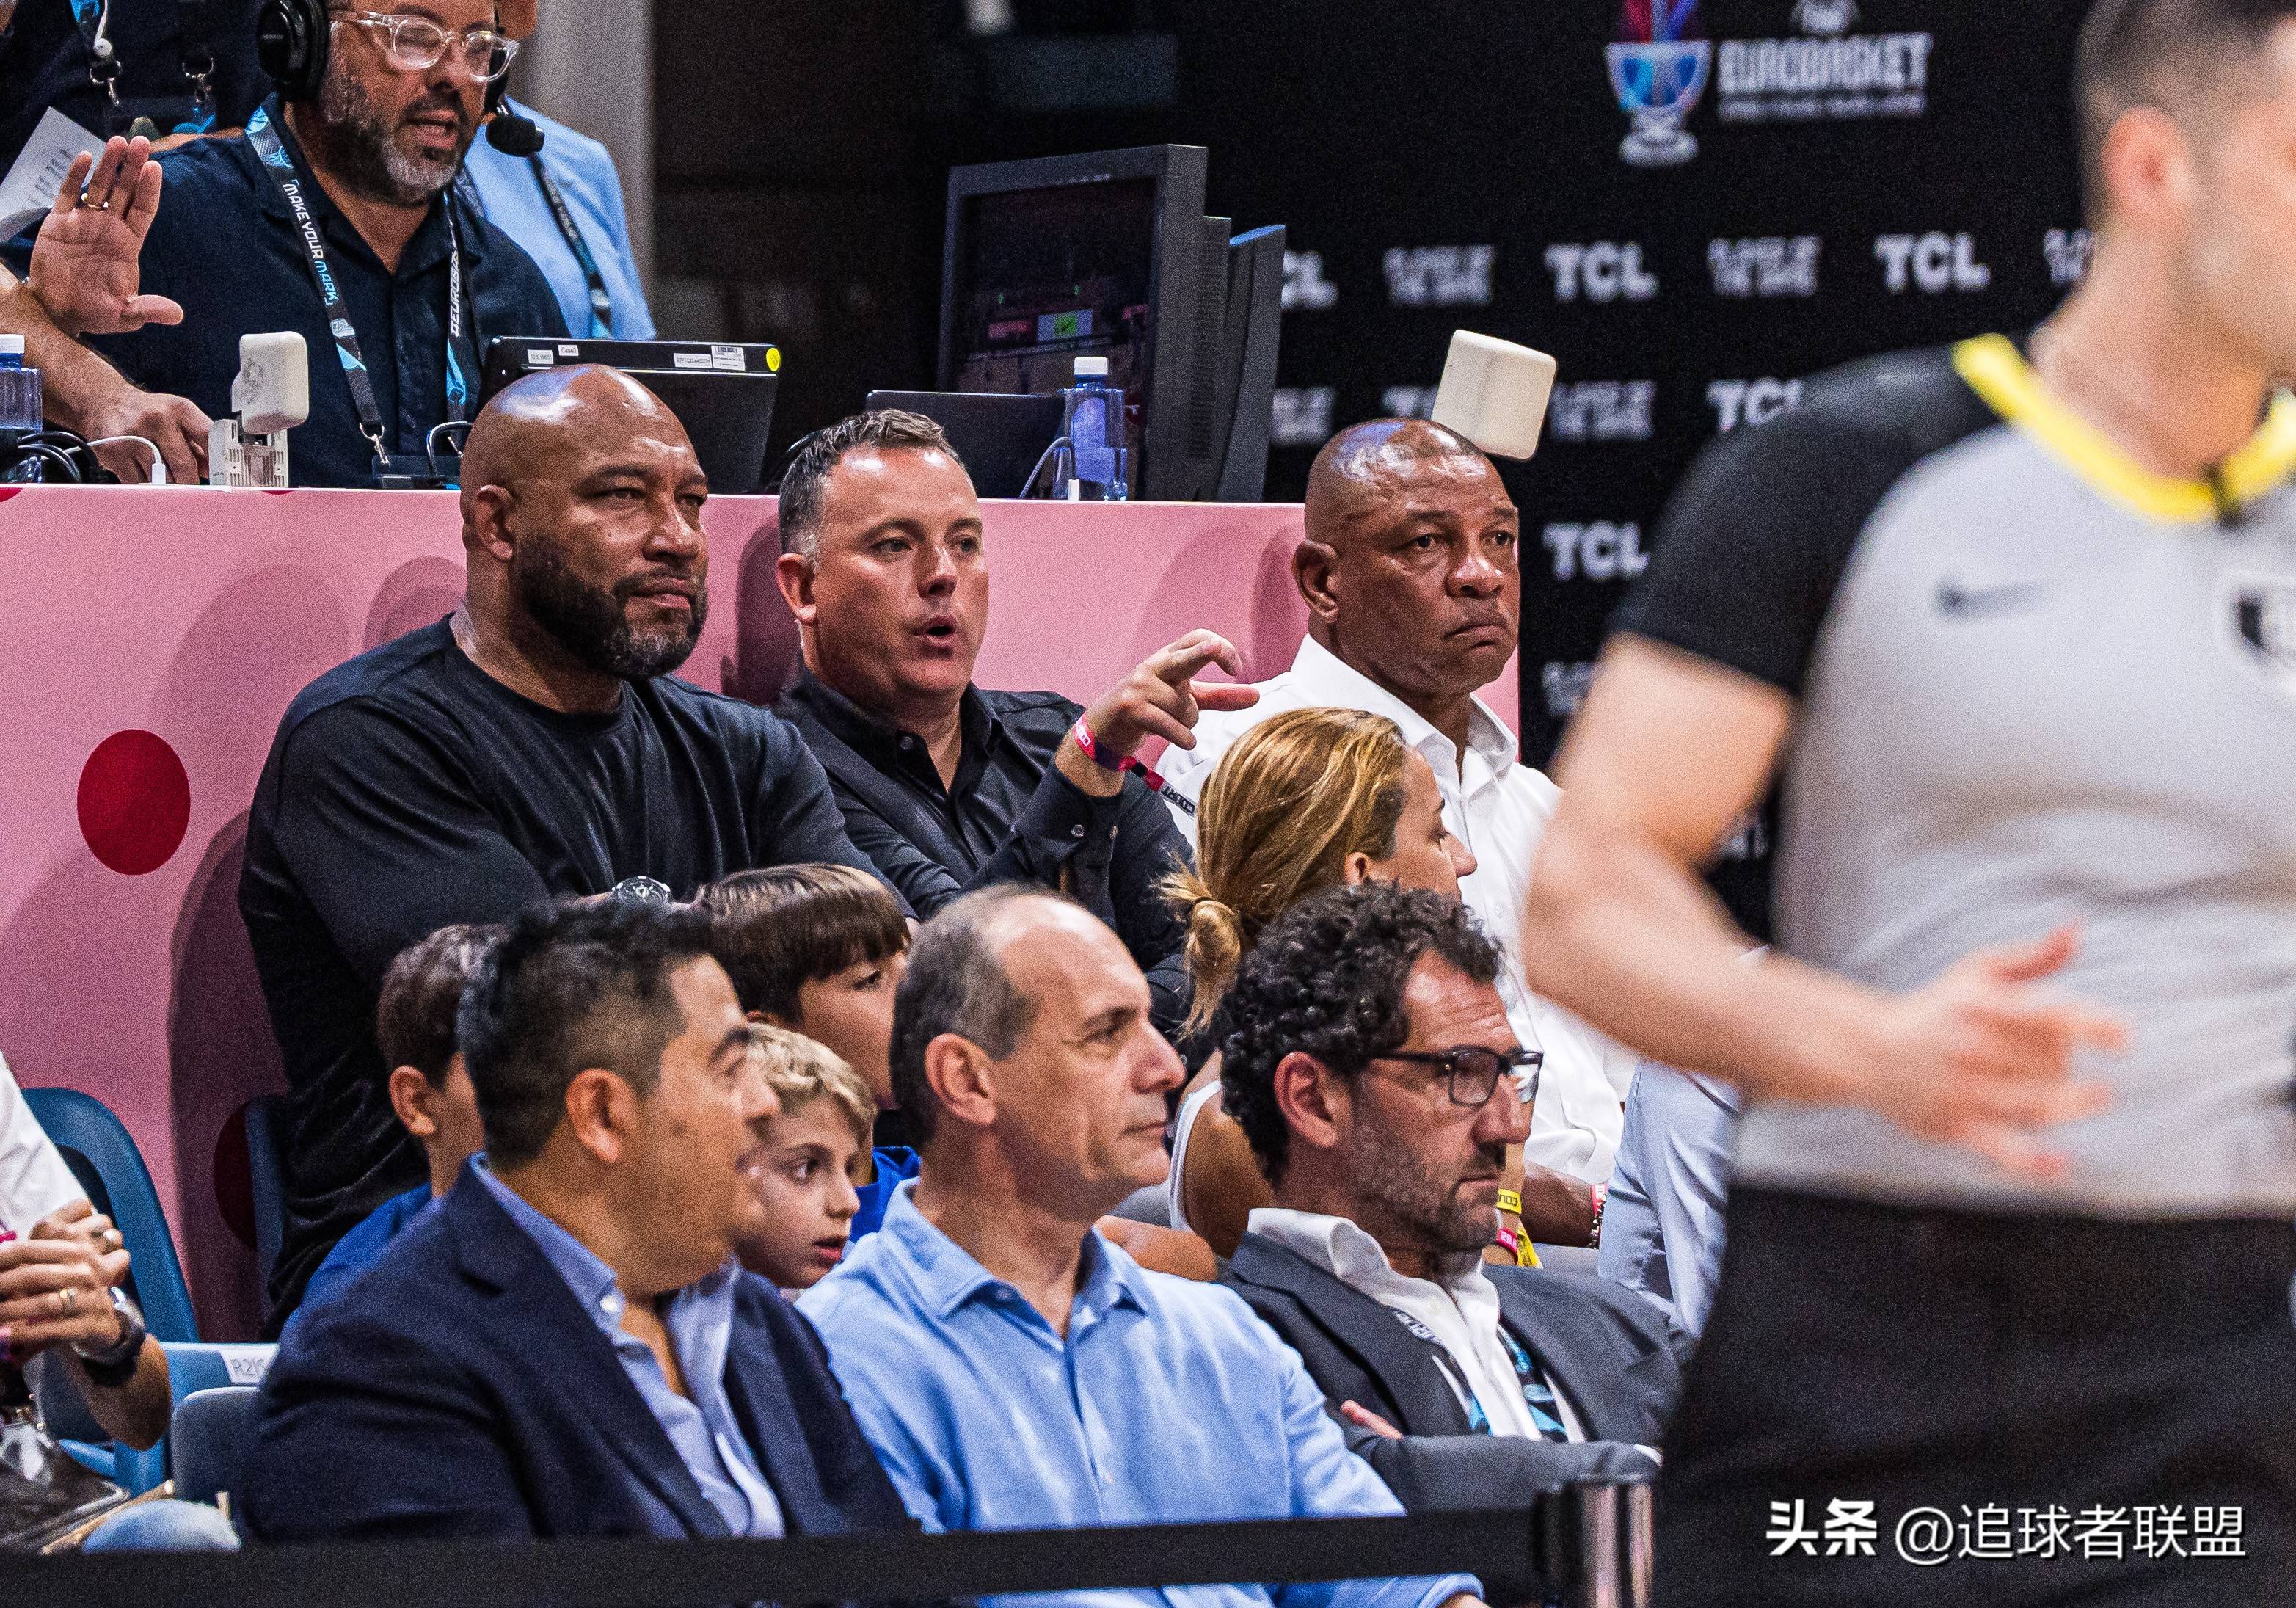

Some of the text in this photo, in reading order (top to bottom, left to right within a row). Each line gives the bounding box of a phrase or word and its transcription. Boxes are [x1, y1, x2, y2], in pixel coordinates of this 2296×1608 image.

[283, 183, 339, 301] MAKE YOUR MARK
[1545, 241, 1657, 299] TCL
[1873, 231, 1990, 292] TCL
[1281, 250, 1338, 309] CL
[1543, 521, 1649, 580] TCL
[1499, 1194, 1517, 1206] COU
